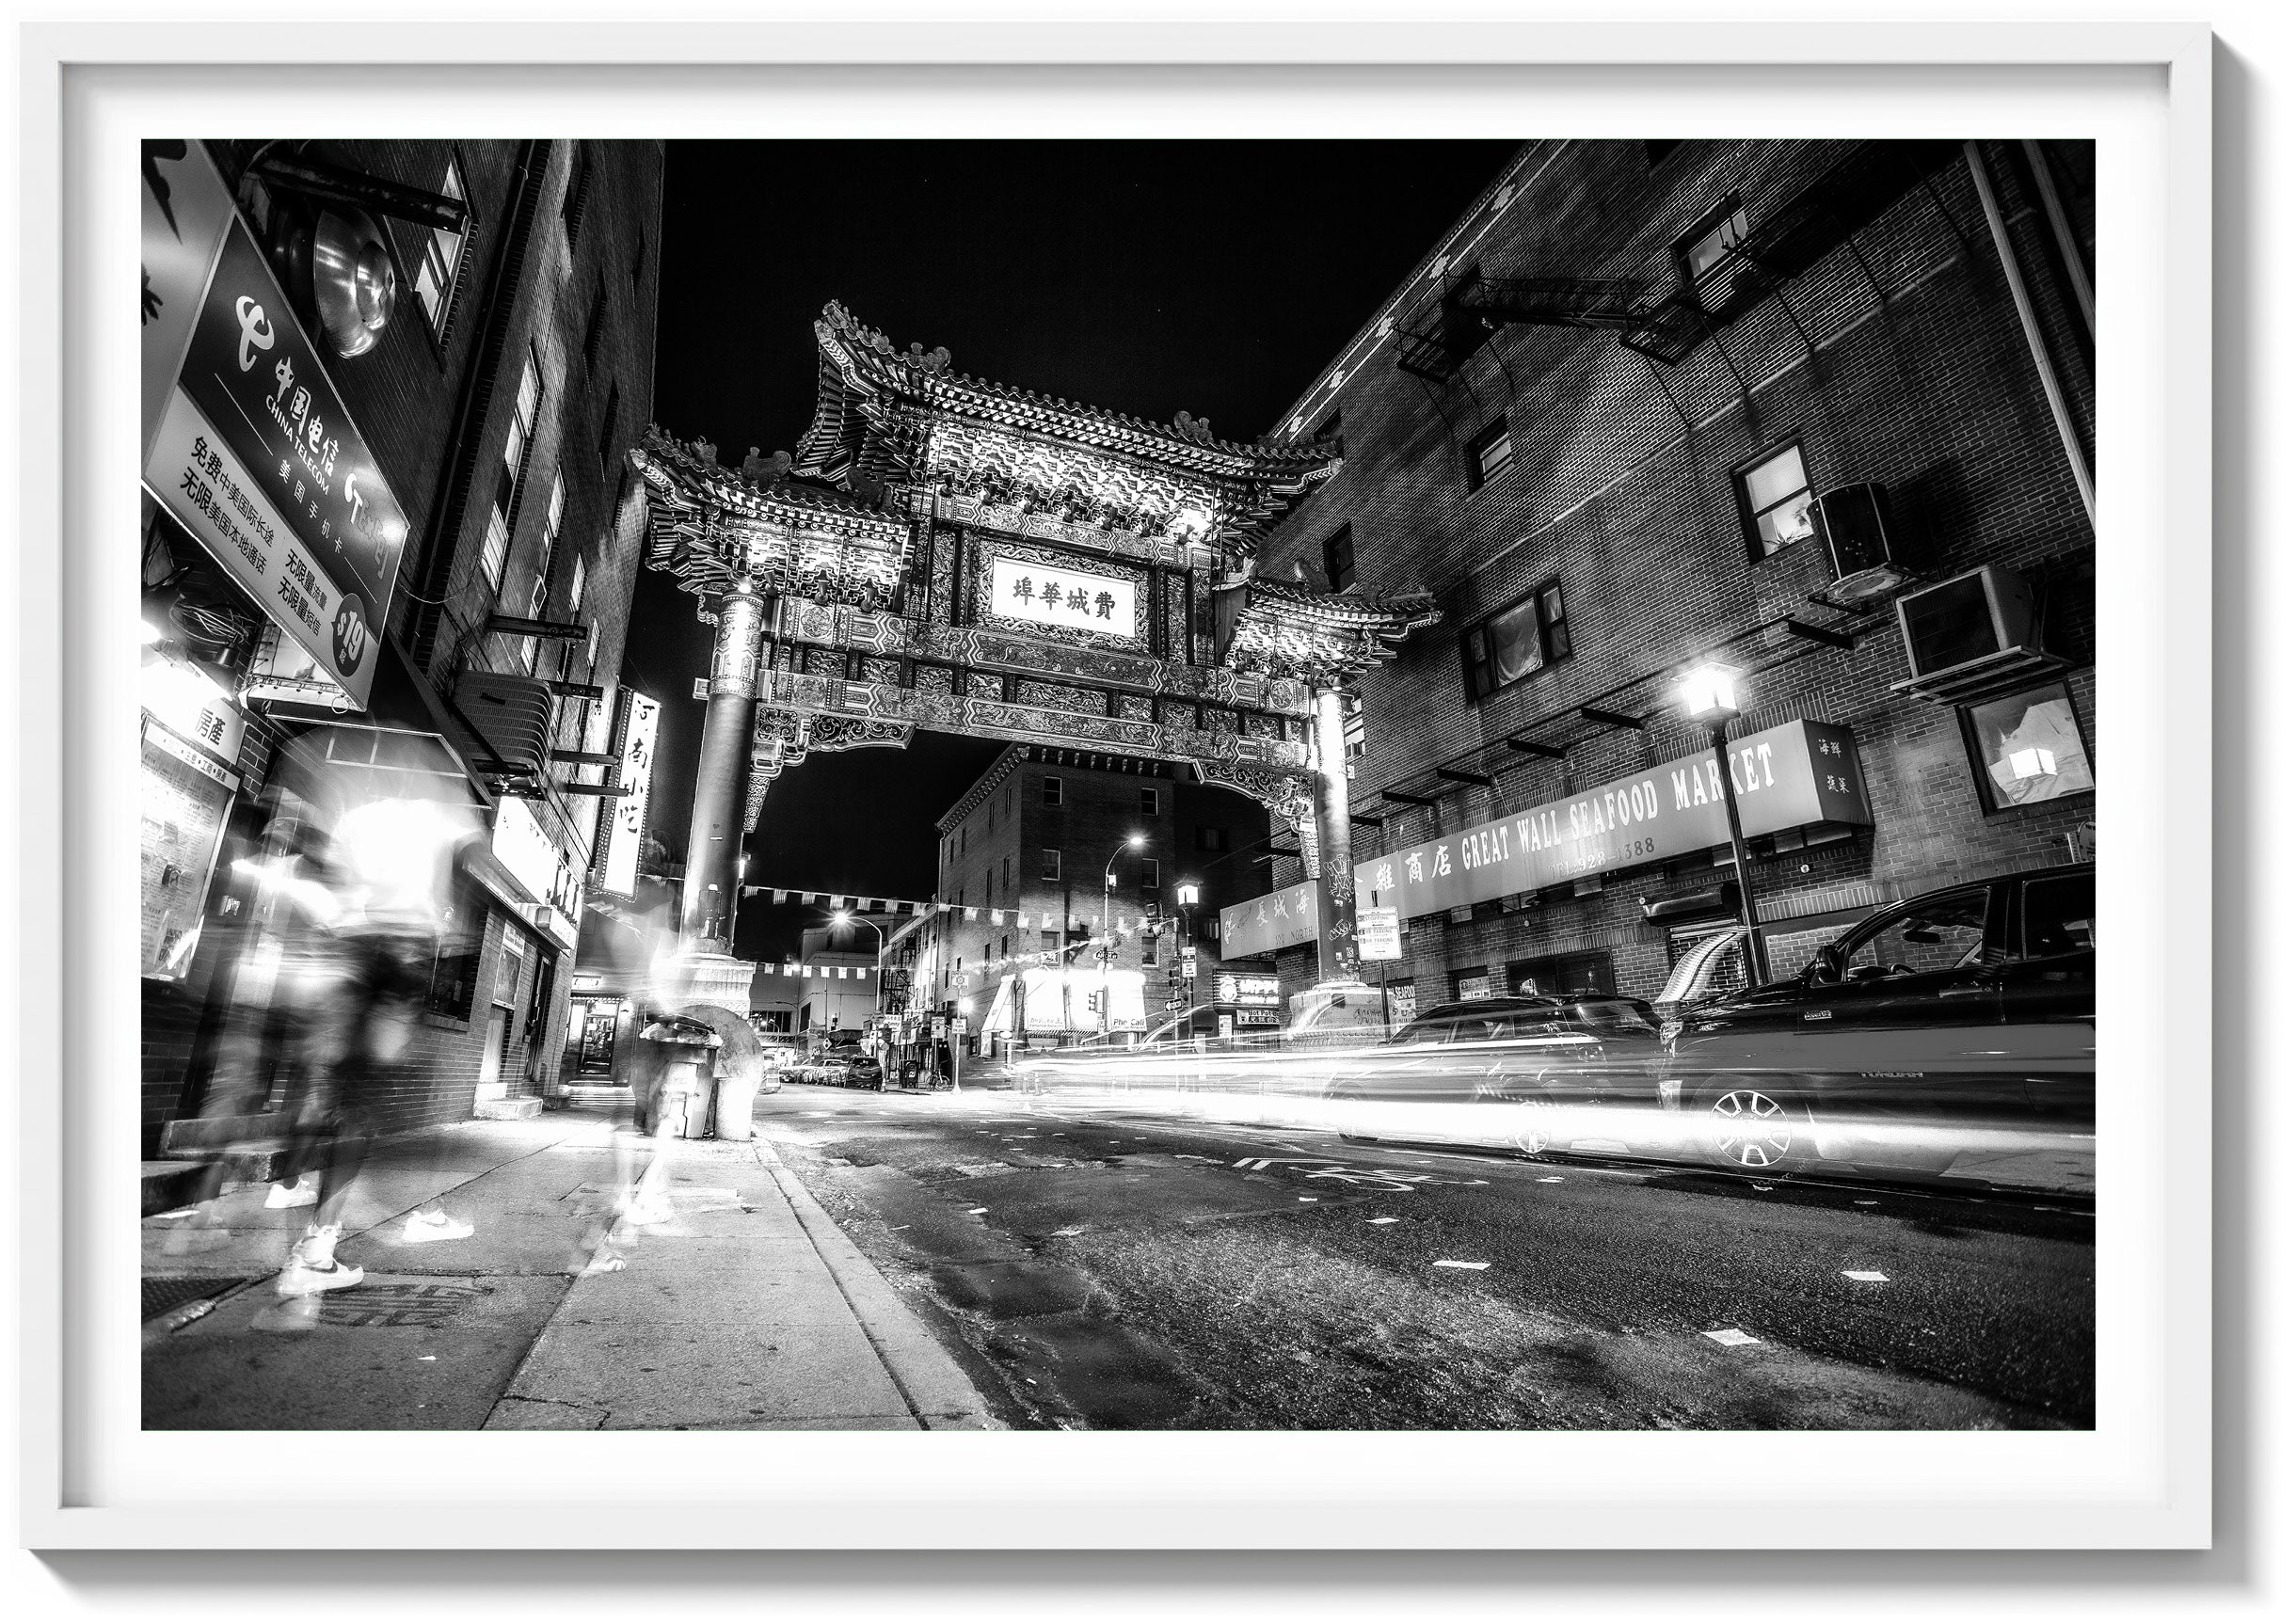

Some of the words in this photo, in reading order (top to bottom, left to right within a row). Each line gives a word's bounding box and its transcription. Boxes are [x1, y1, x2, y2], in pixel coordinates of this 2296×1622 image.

[264, 394, 294, 442] CHINA
[294, 436, 330, 495] TELECOM
[275, 357, 340, 478] 中国电信
[180, 468, 268, 575] 无限美国本地通话
[191, 436, 275, 548] 免费中美国际长途
[279, 458, 344, 554] 美国手机卡
[277, 578, 321, 637] 无限量短信
[284, 549, 327, 612] 无限量流量
[337, 610, 364, 661] $19
[1461, 825, 1509, 871] GREAT
[1517, 810, 1562, 855] WALL
[1569, 779, 1658, 838] SEAFOOD
[1671, 742, 1776, 811] MARKET
